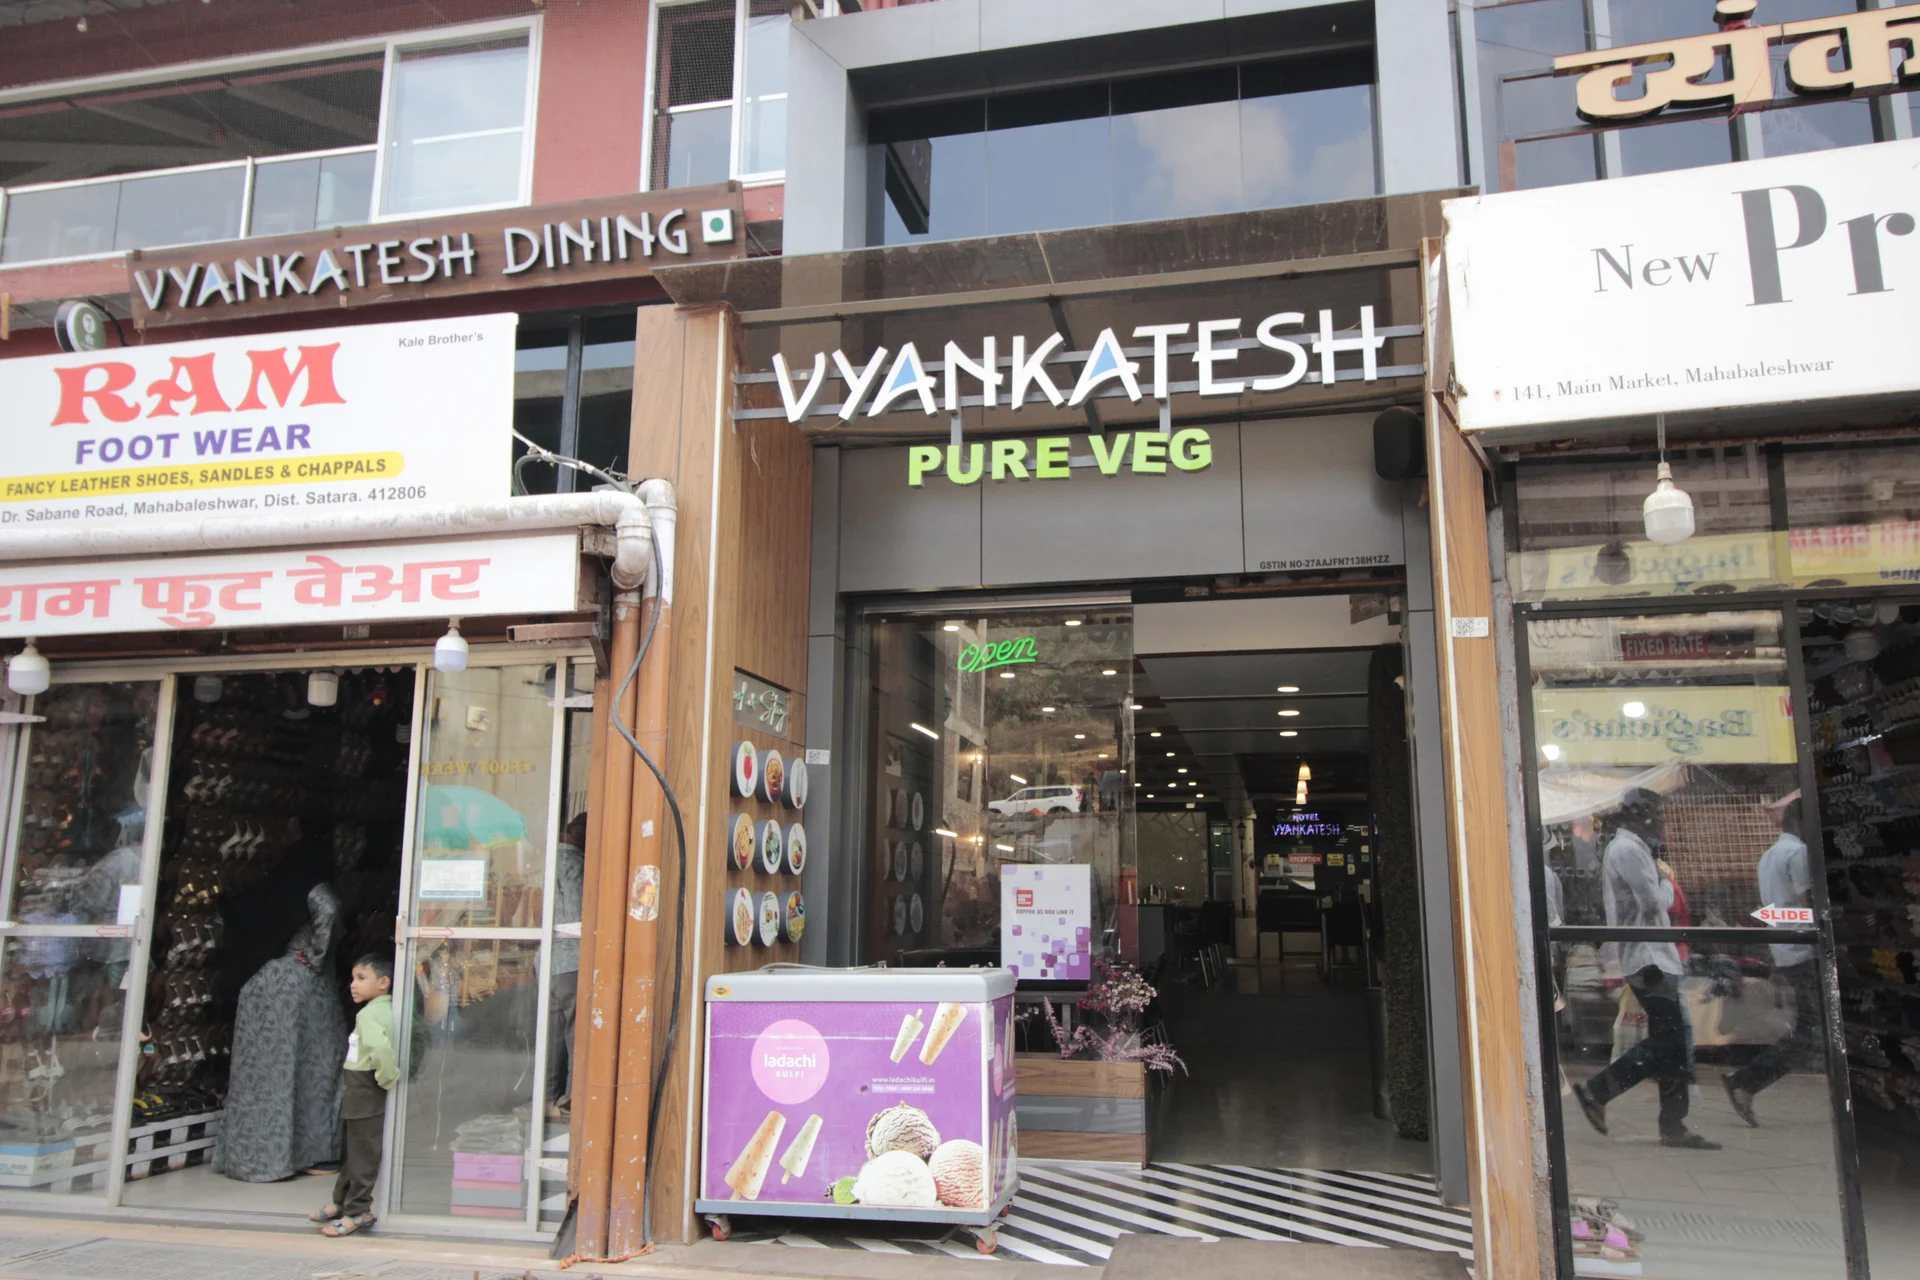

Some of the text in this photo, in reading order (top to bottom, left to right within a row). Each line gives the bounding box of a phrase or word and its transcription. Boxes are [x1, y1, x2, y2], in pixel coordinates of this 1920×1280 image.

[134, 208, 689, 311] VYANKATESH DINING
[1591, 184, 1916, 307] New Pr
[398, 332, 484, 348] Kale Brother's
[772, 305, 1385, 423] VYANKATESH
[1513, 358, 1834, 401] 141, Main Market, Mahabaleshwar
[50, 342, 347, 427] RAM
[75, 424, 311, 465] FOOT WEAR
[908, 428, 1213, 488] PURE VEG
[6, 458, 386, 496] FANCY LEATHER SHOES, SANDLES & CHAPPALS
[2, 486, 426, 523] Dr. Sabane Road, Mahabaleshwar, Dist. Satara. 412806
[1260, 561, 1287, 570] GSTIN
[133, 571, 273, 629] फुट
[286, 555, 491, 607] वेअर
[957, 638, 1038, 672] open
[1625, 634, 1705, 656] FIXED RATE
[1272, 823, 1341, 836] VYANKATESH
[1292, 812, 1320, 821] HOTEL
[1760, 909, 1809, 921] SLIDE
[764, 1053, 817, 1068] ladachi
[775, 1070, 804, 1078] KULFI
